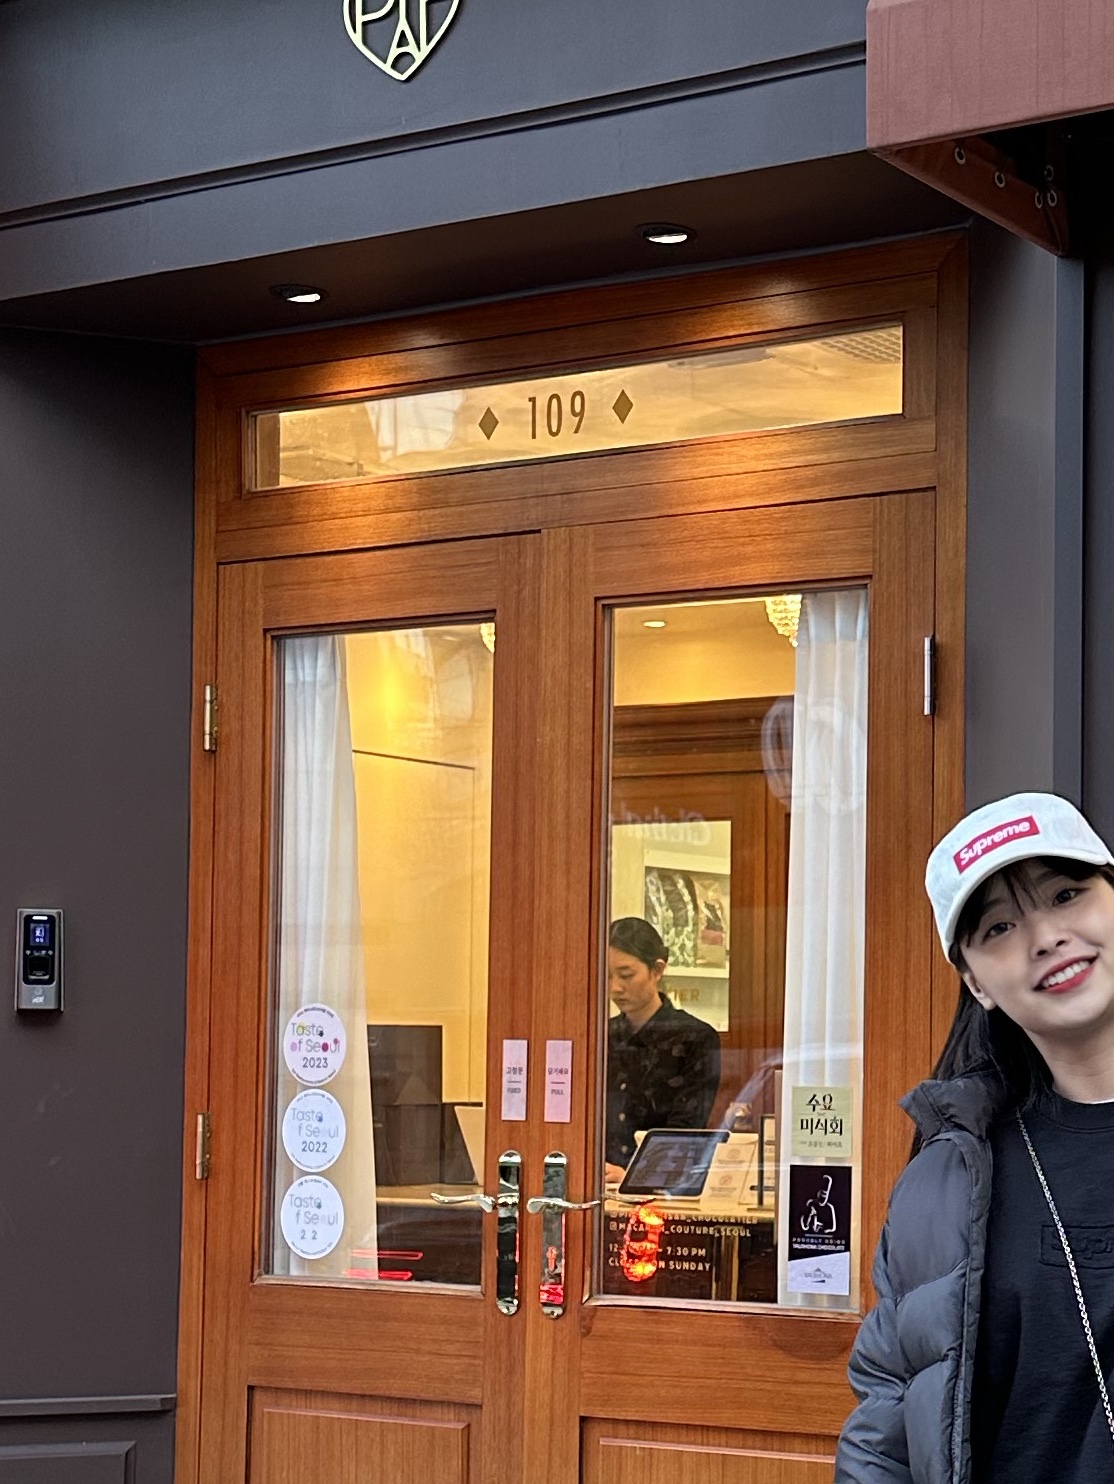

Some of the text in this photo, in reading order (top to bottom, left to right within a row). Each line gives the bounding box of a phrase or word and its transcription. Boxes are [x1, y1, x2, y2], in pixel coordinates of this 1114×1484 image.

[528, 390, 585, 439] 109
[960, 821, 1031, 866] Supreme
[291, 1023, 324, 1037] Taste
[303, 1057, 328, 1068] 2023
[806, 1093, 836, 1112] 수요
[291, 1108, 323, 1122] Taste
[801, 1116, 843, 1136] 미식회
[302, 1141, 328, 1153] 2022
[289, 1194, 322, 1209] Taste
[691, 1248, 706, 1257] PM
[669, 1261, 711, 1271] SUNDAY
